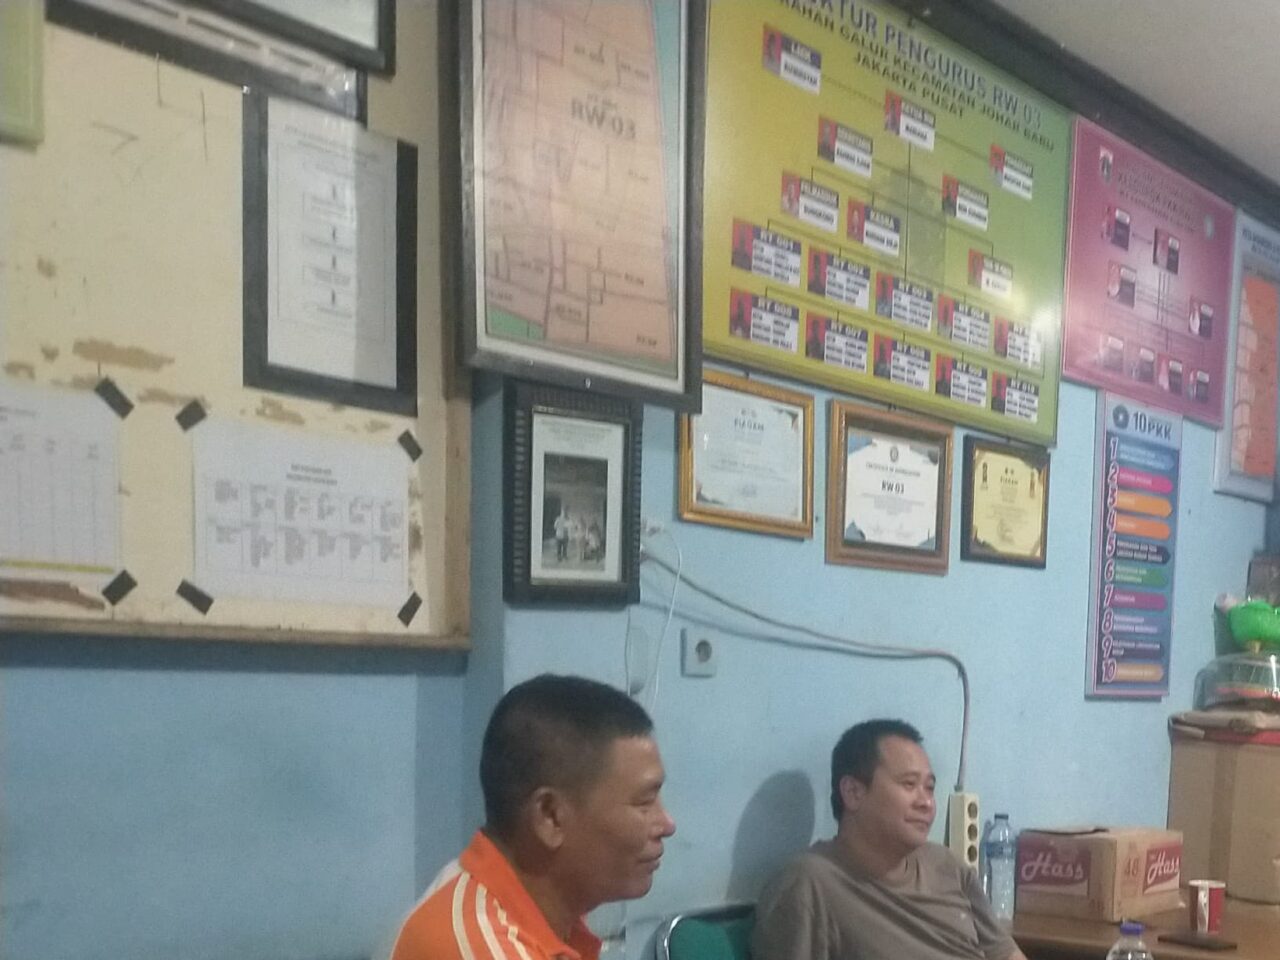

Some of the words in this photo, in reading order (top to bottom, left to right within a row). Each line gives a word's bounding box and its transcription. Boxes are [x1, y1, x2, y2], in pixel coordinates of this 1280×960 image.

[839, 24, 888, 61] GALUR
[893, 53, 976, 109] KECAMATAN
[885, 22, 986, 99] PENGURUS
[993, 84, 1018, 116] RW
[856, 51, 917, 93] JAKARTA
[922, 86, 963, 120] PUSAT
[570, 97, 607, 131] RW
[881, 479, 894, 493] RW
[1107, 463, 1119, 485] 2
[1104, 559, 1115, 581] 6
[1102, 609, 1114, 634] 8
[1102, 635, 1114, 658] 9
